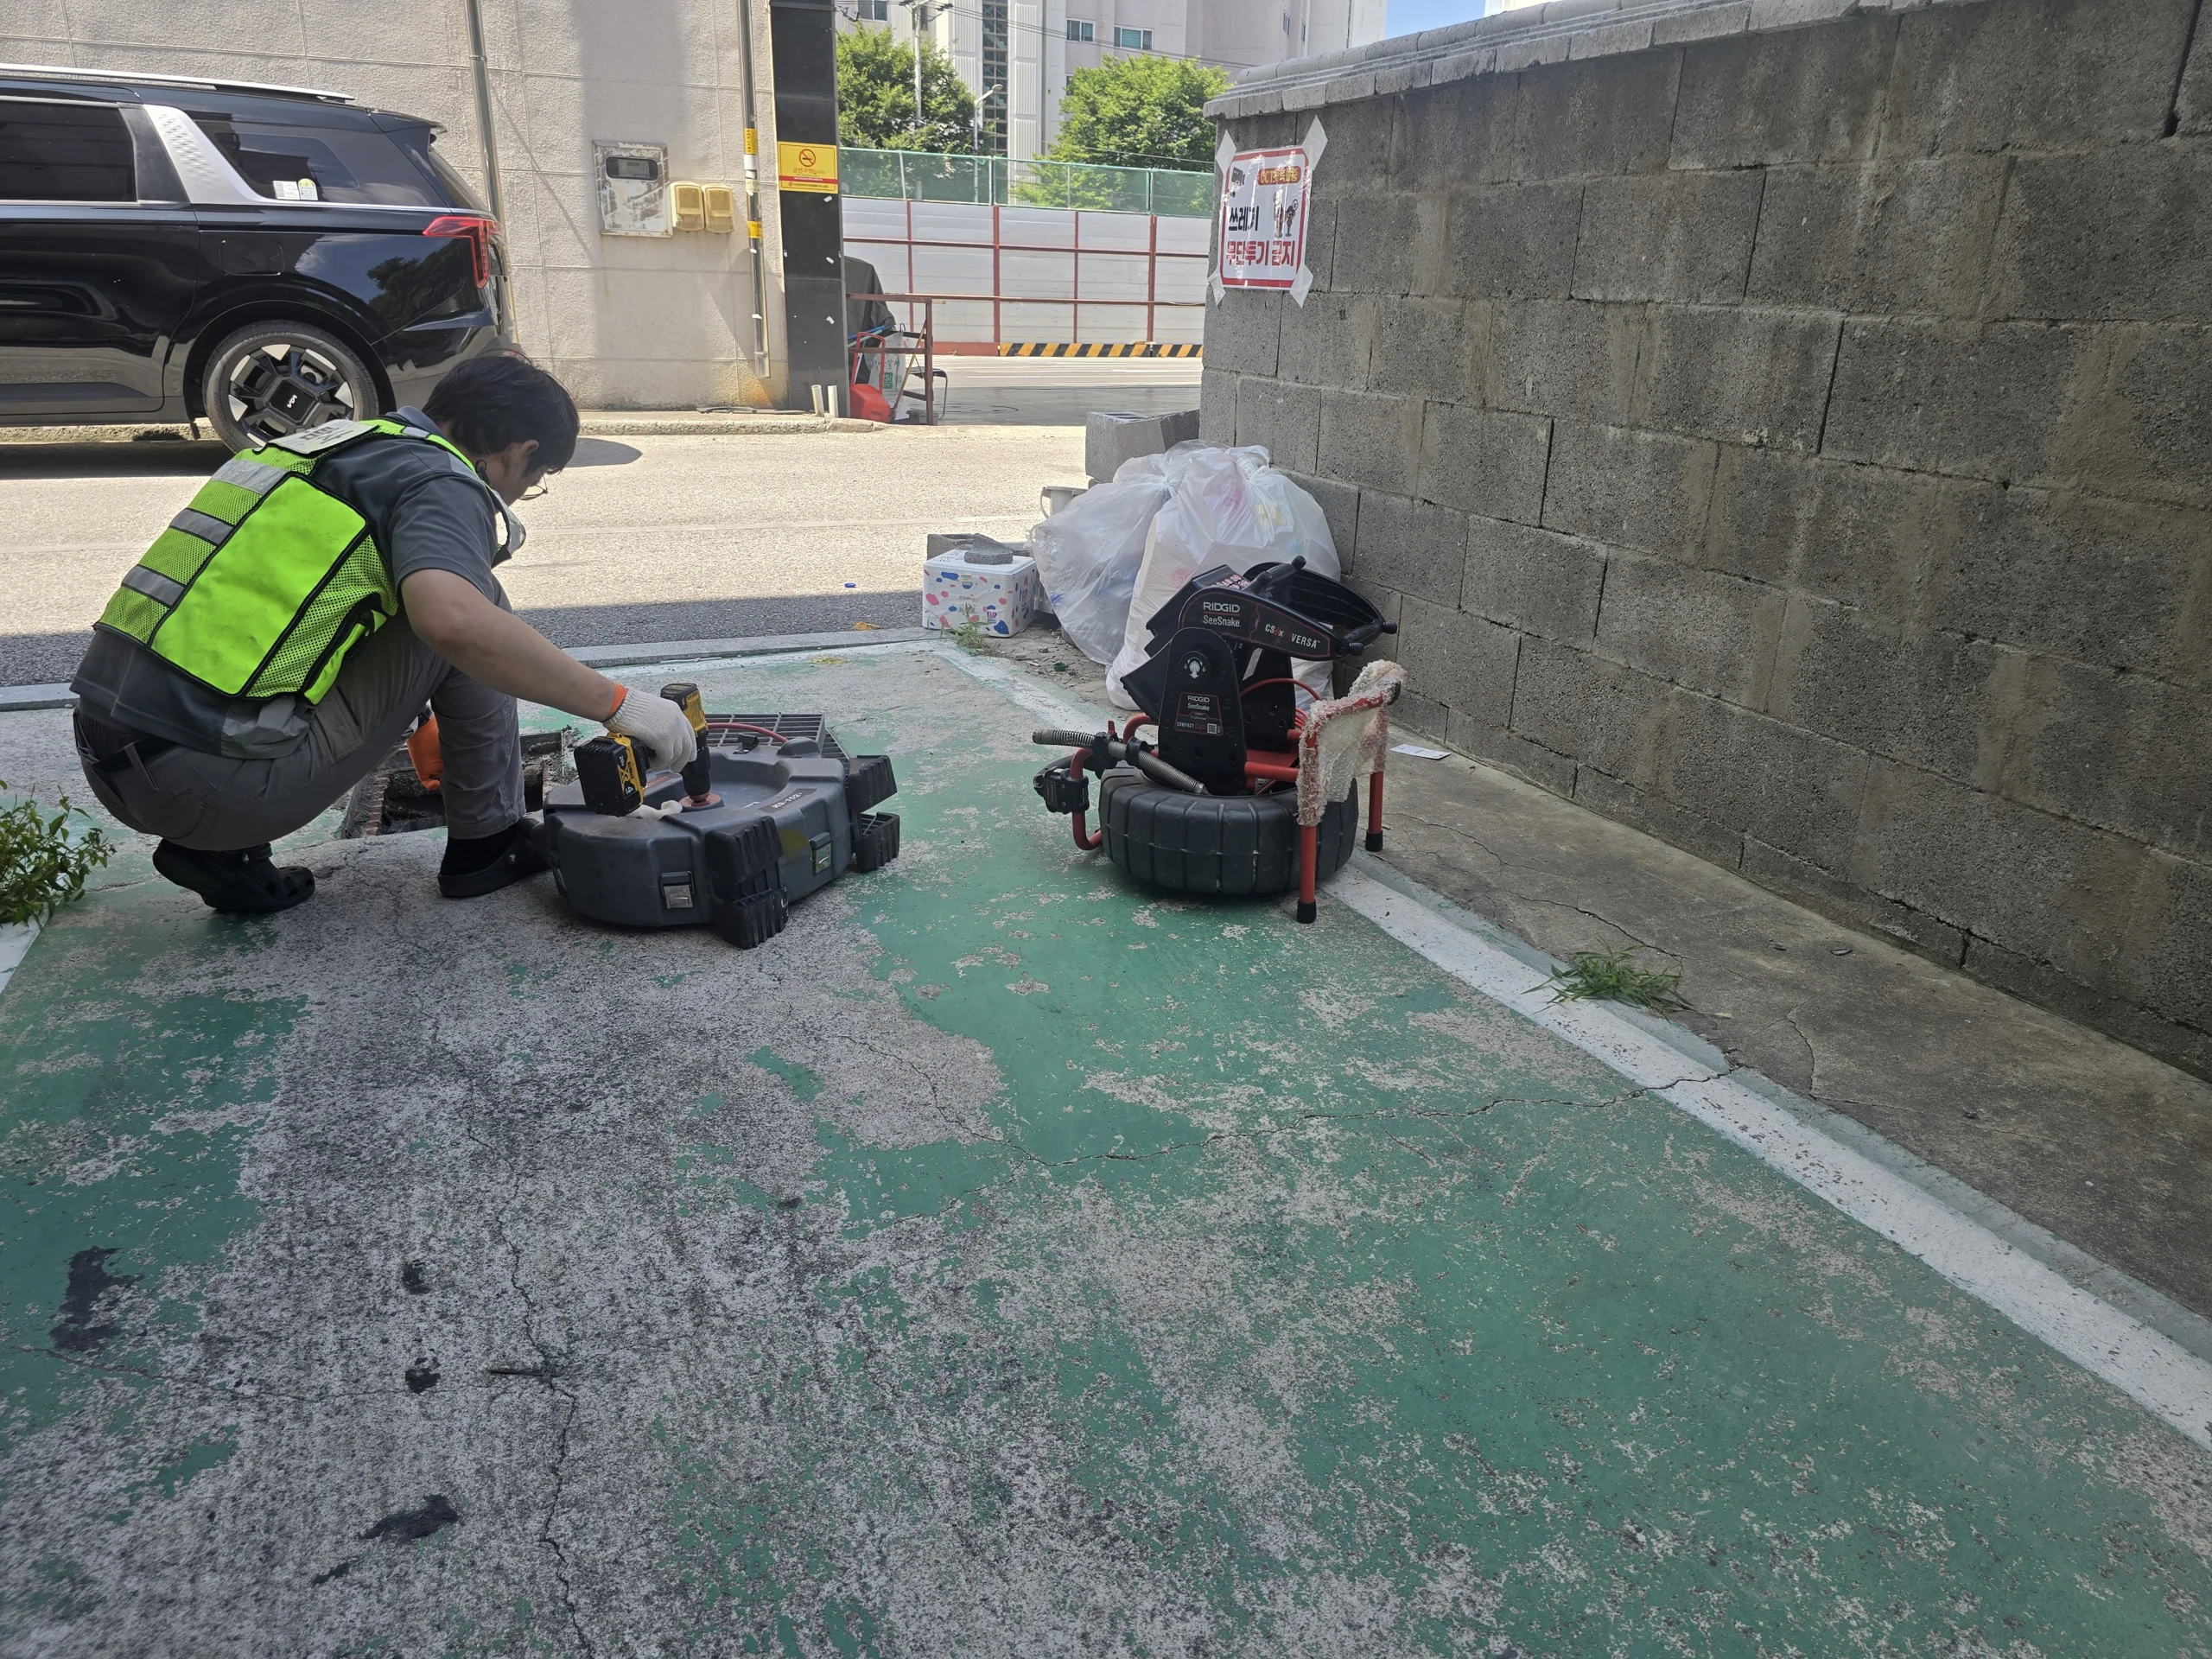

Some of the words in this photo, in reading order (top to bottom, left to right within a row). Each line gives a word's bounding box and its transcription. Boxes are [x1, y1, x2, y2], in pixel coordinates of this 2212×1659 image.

[1228, 206, 1260, 232] 쓰레기
[1226, 240, 1270, 266] 무단투기
[1271, 240, 1295, 267] 금지
[1203, 601, 1241, 613] RIDGID
[1187, 695, 1210, 703] RIDGID
